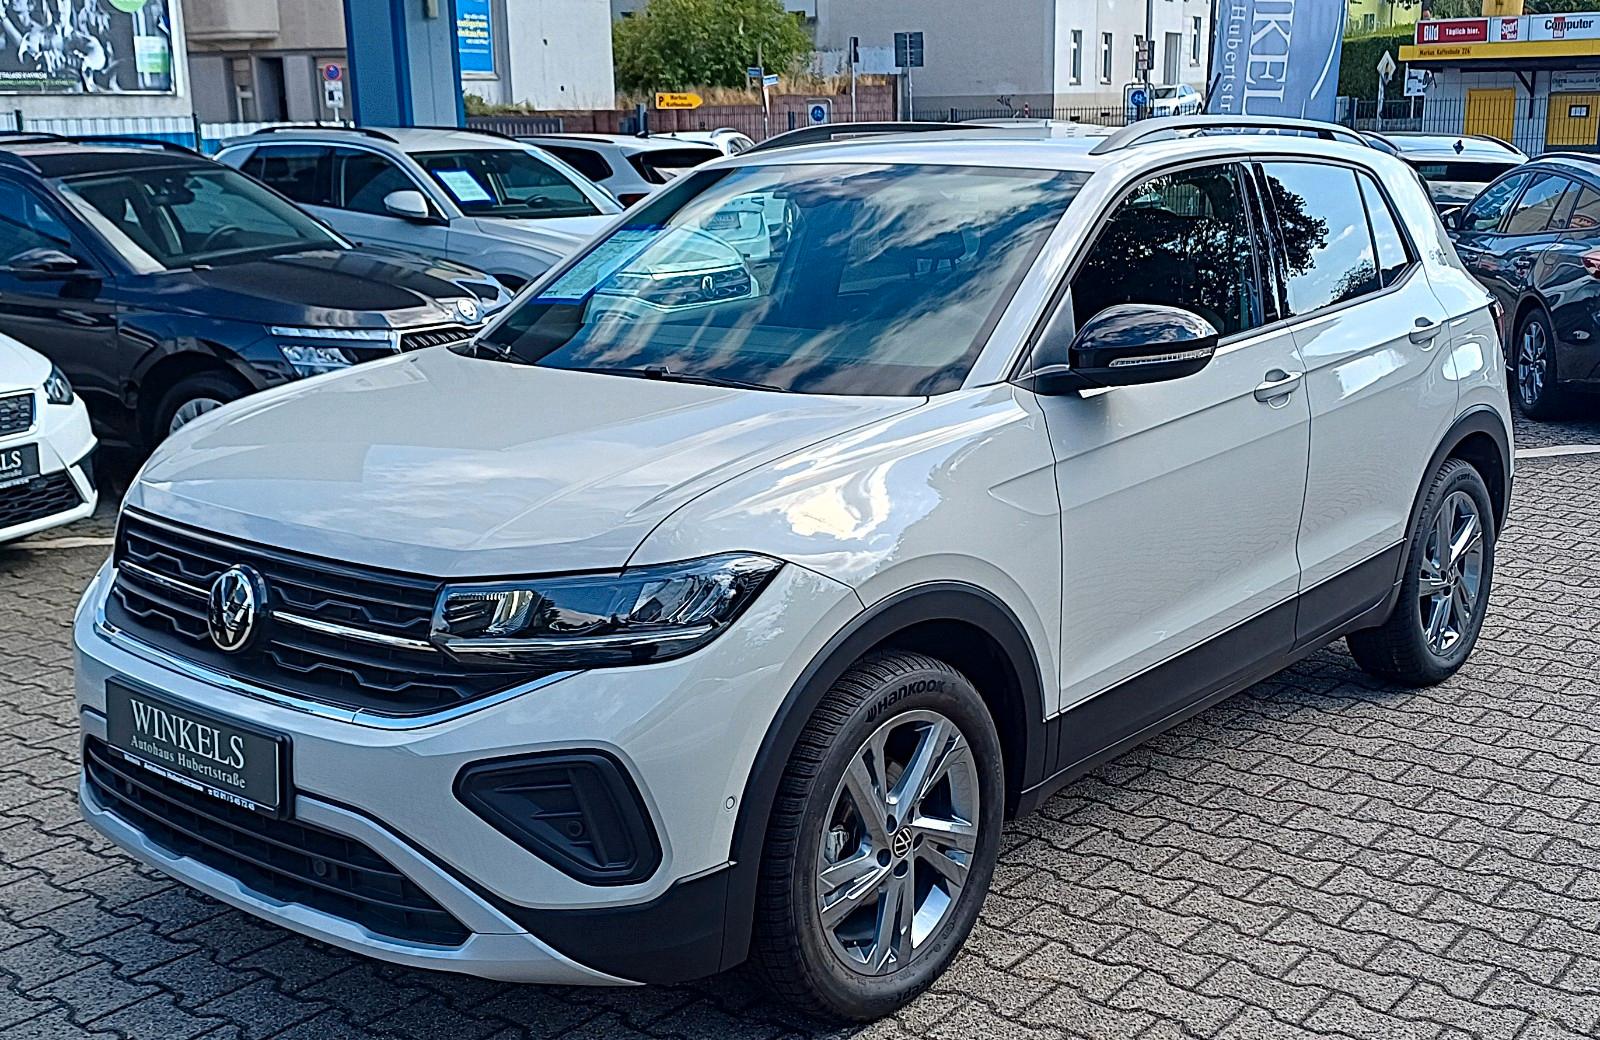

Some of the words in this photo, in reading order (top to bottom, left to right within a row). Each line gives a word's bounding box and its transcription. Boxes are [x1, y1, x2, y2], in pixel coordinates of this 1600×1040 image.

[1424, 24, 1439, 41] Bild
[1446, 26, 1465, 36] Täglich
[1544, 18, 1595, 32] Computer
[1219, 4, 1247, 113] Hubertstr
[1241, 0, 1296, 120] KEL
[0, 451, 22, 471] LS
[131, 699, 245, 769] WINKELS
[131, 735, 175, 763] Autohaus
[178, 751, 246, 789] Hubertstraße
